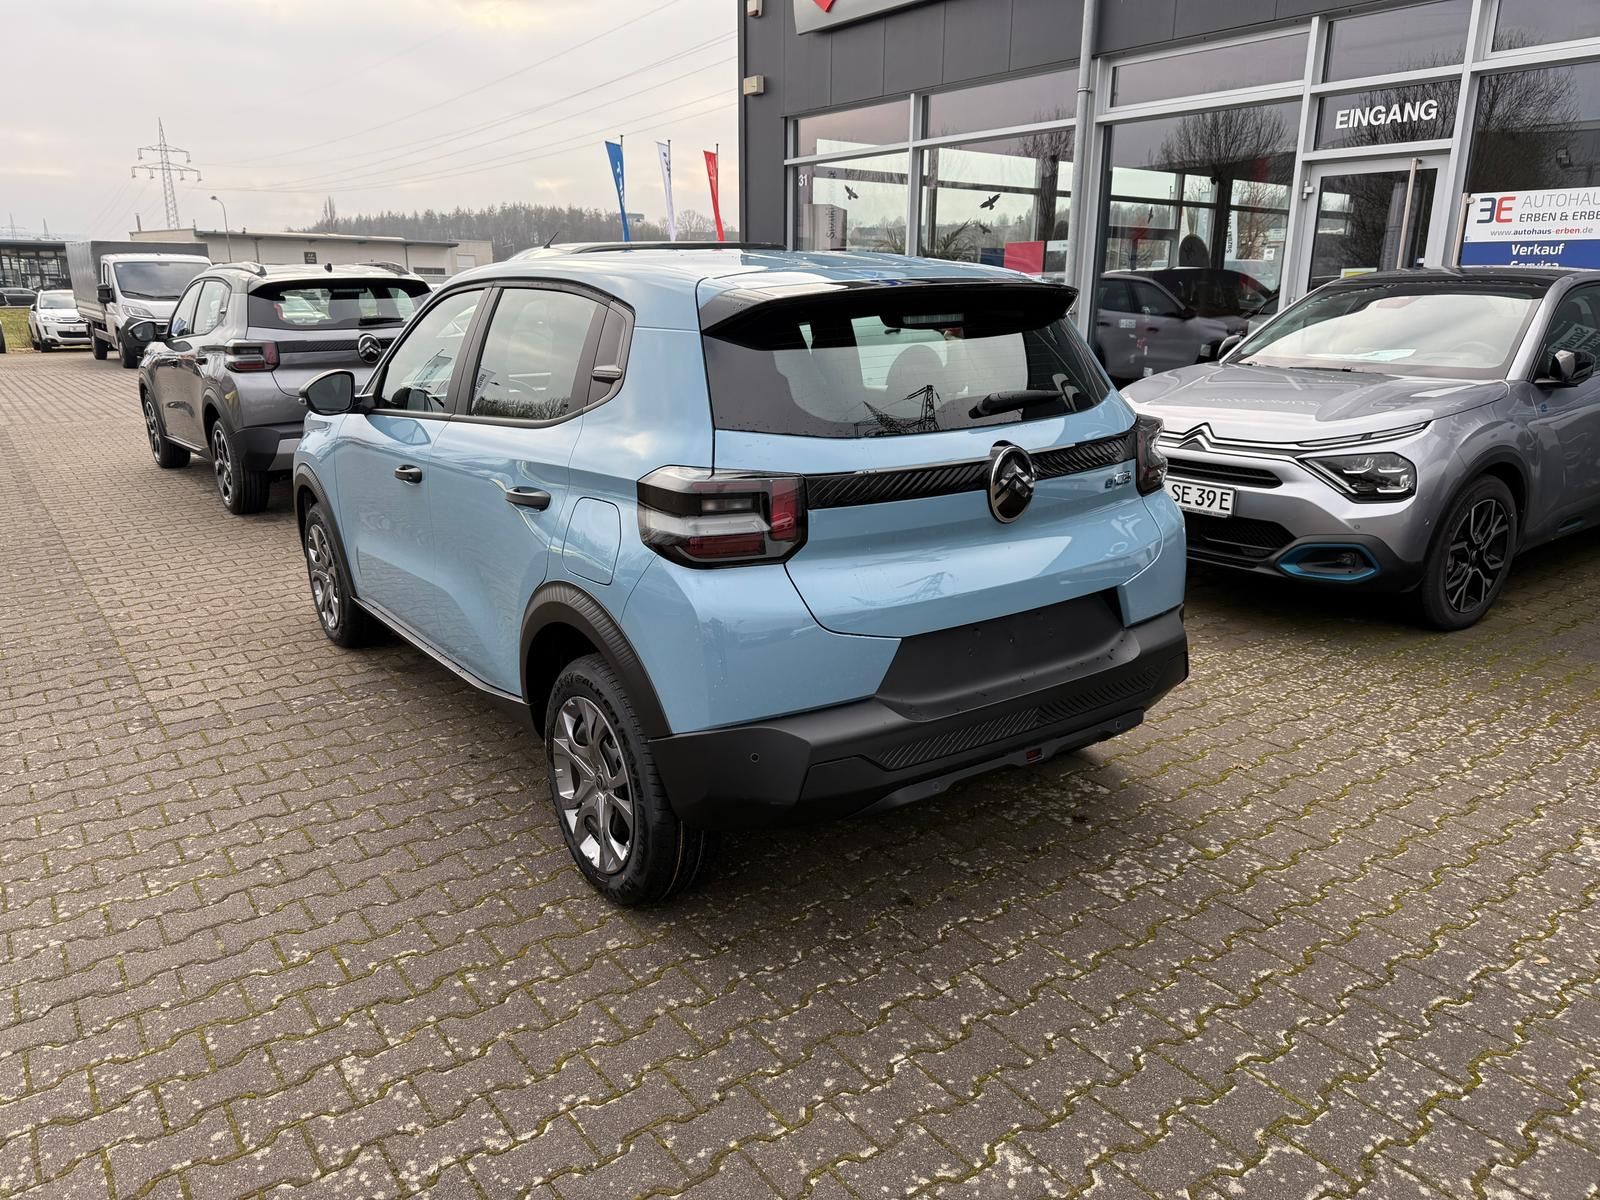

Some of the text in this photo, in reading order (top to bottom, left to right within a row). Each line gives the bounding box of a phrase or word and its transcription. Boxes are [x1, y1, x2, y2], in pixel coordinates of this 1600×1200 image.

[1335, 99, 1438, 129] EINGANG
[798, 174, 808, 187] 31
[1519, 212, 1557, 223] ERBEN
[1560, 211, 1569, 221] &
[1490, 226, 1594, 236] www.autohaus-erben.de
[1511, 243, 1565, 255] Verkauf
